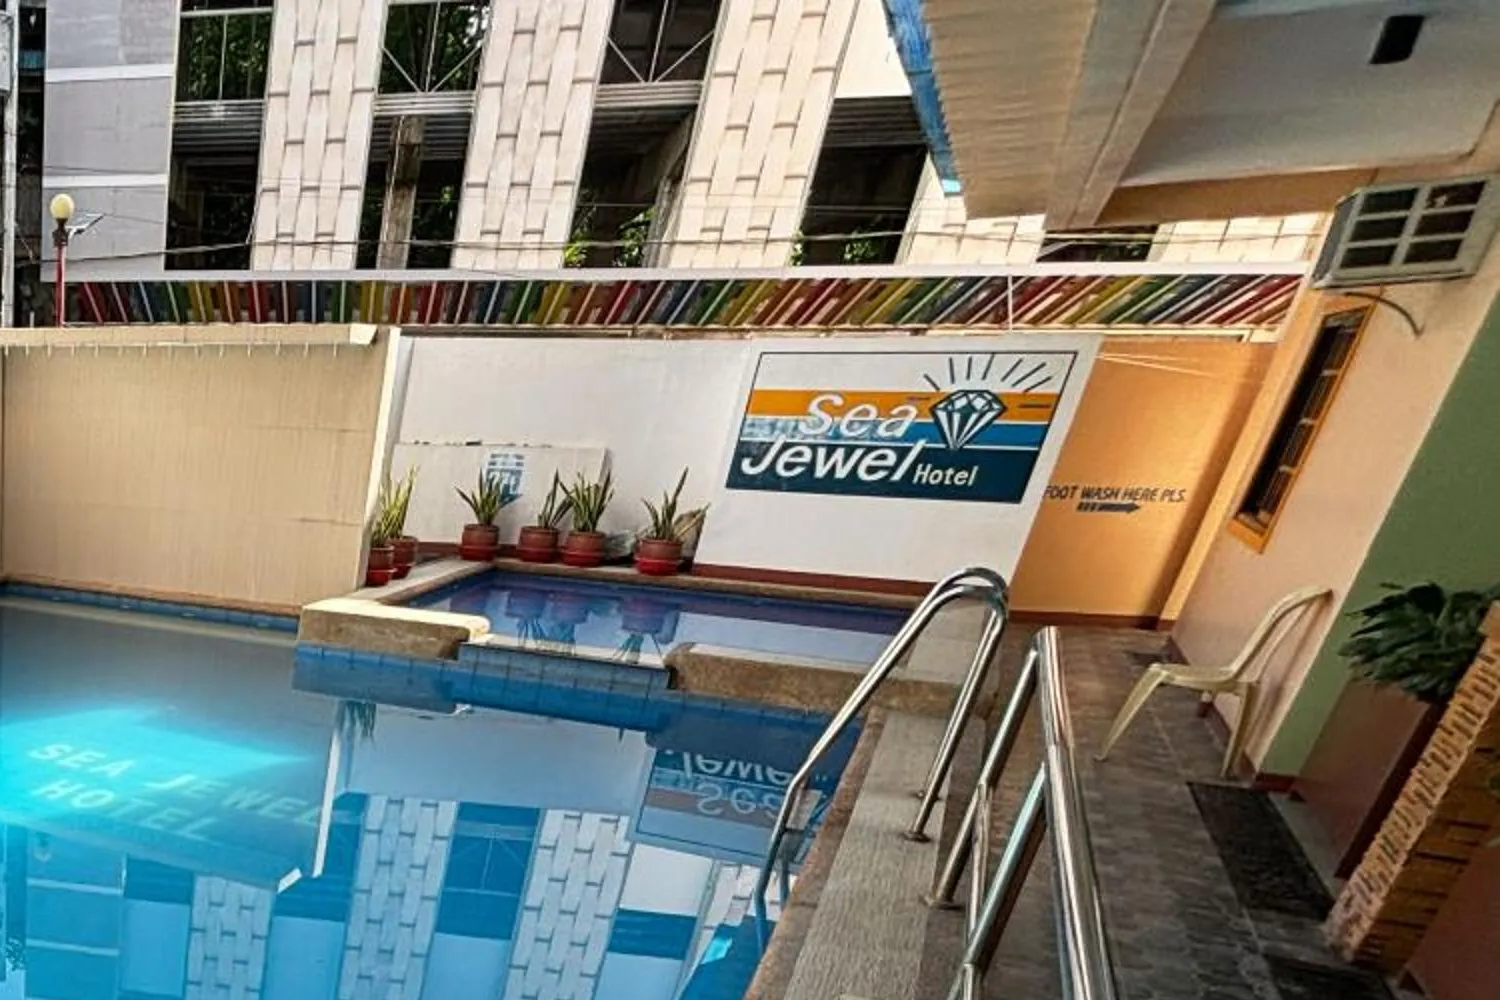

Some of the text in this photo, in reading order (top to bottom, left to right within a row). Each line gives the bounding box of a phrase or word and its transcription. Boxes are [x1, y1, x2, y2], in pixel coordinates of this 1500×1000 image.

[800, 393, 918, 438] Sea
[741, 435, 978, 486] Jewel Hotel
[1043, 485, 1078, 500] FOOT
[1080, 486, 1119, 501] WASH
[1121, 486, 1160, 502] HERE
[29, 744, 322, 826] SEA JEWEL
[30, 779, 218, 842] HOTEL
